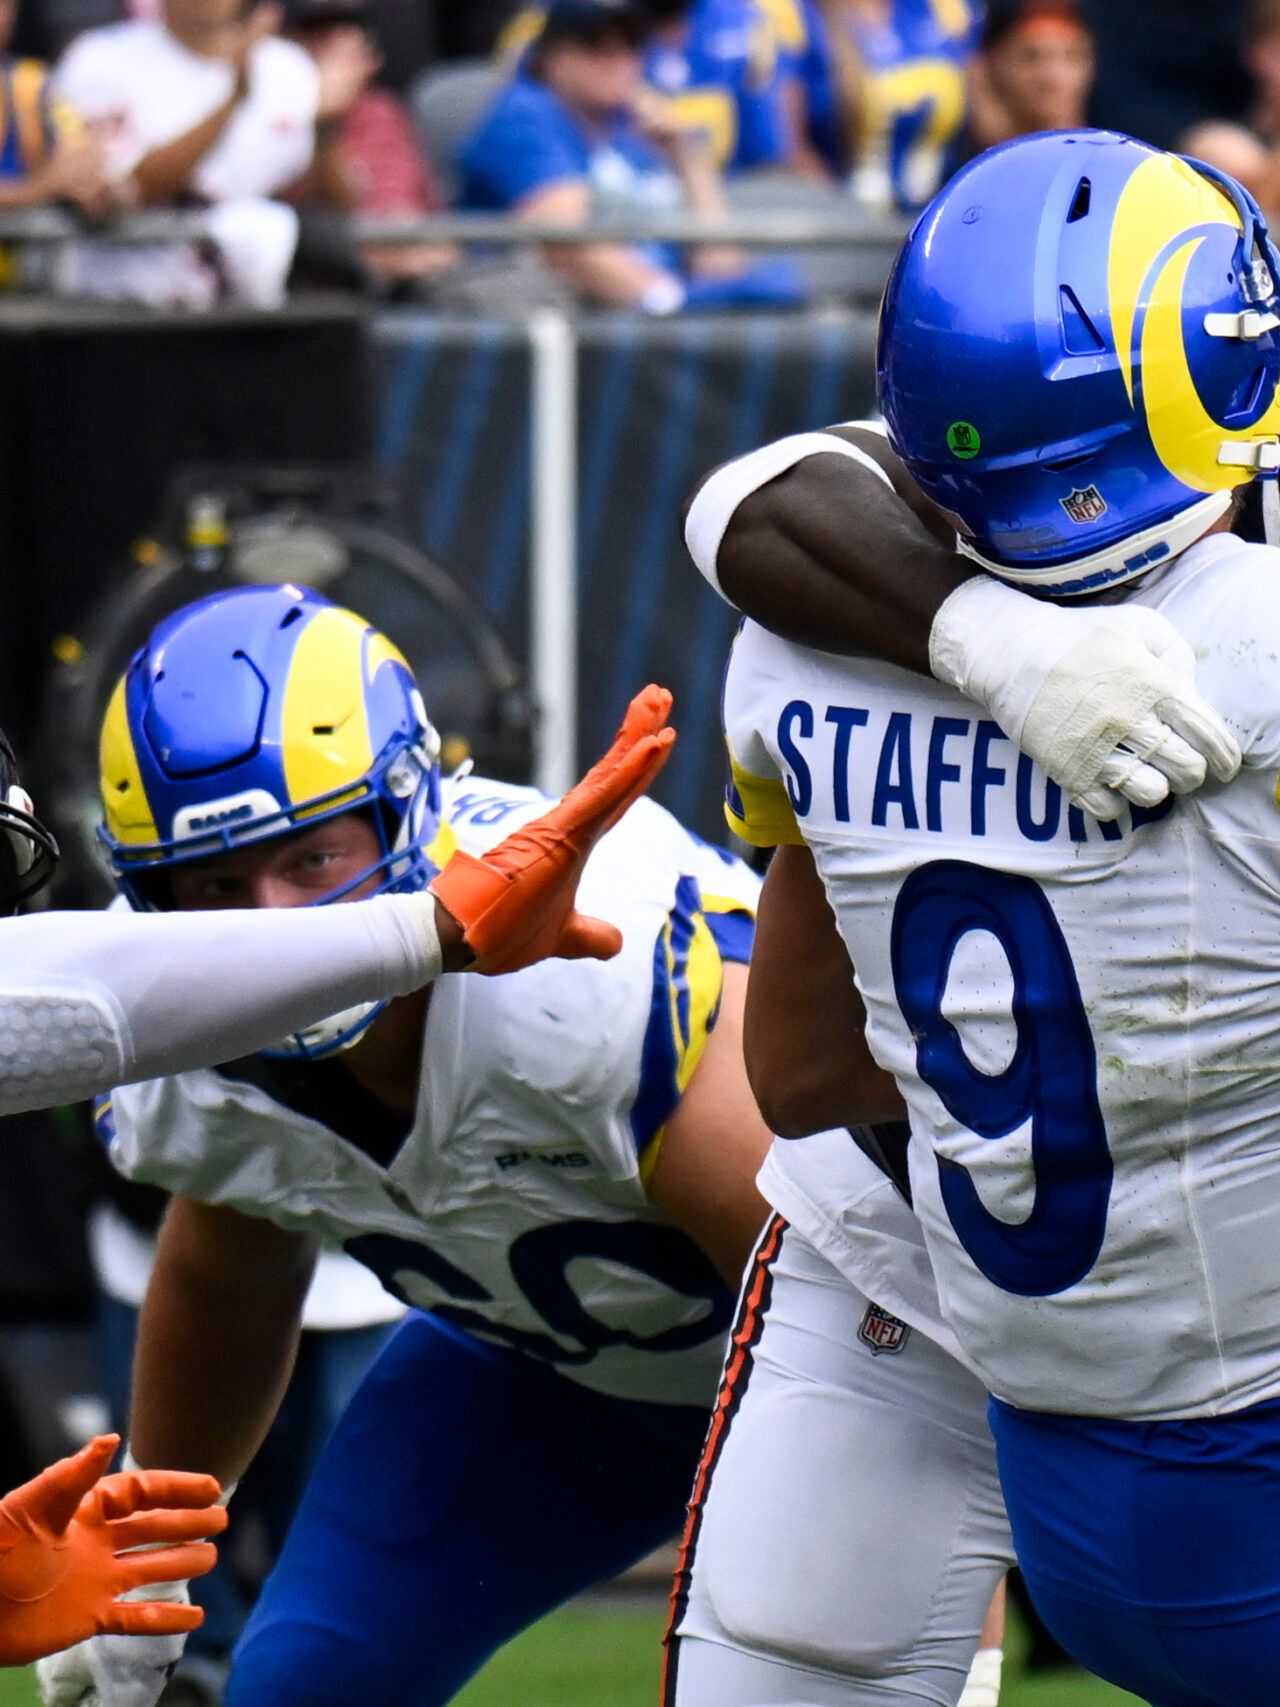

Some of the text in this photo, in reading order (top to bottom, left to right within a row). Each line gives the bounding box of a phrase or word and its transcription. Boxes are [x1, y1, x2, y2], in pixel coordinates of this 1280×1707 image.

[1070, 499, 1102, 522] NFL
[777, 699, 1175, 842] STAFFO
[890, 859, 1114, 1297] 9
[865, 1317, 898, 1345] NFL
